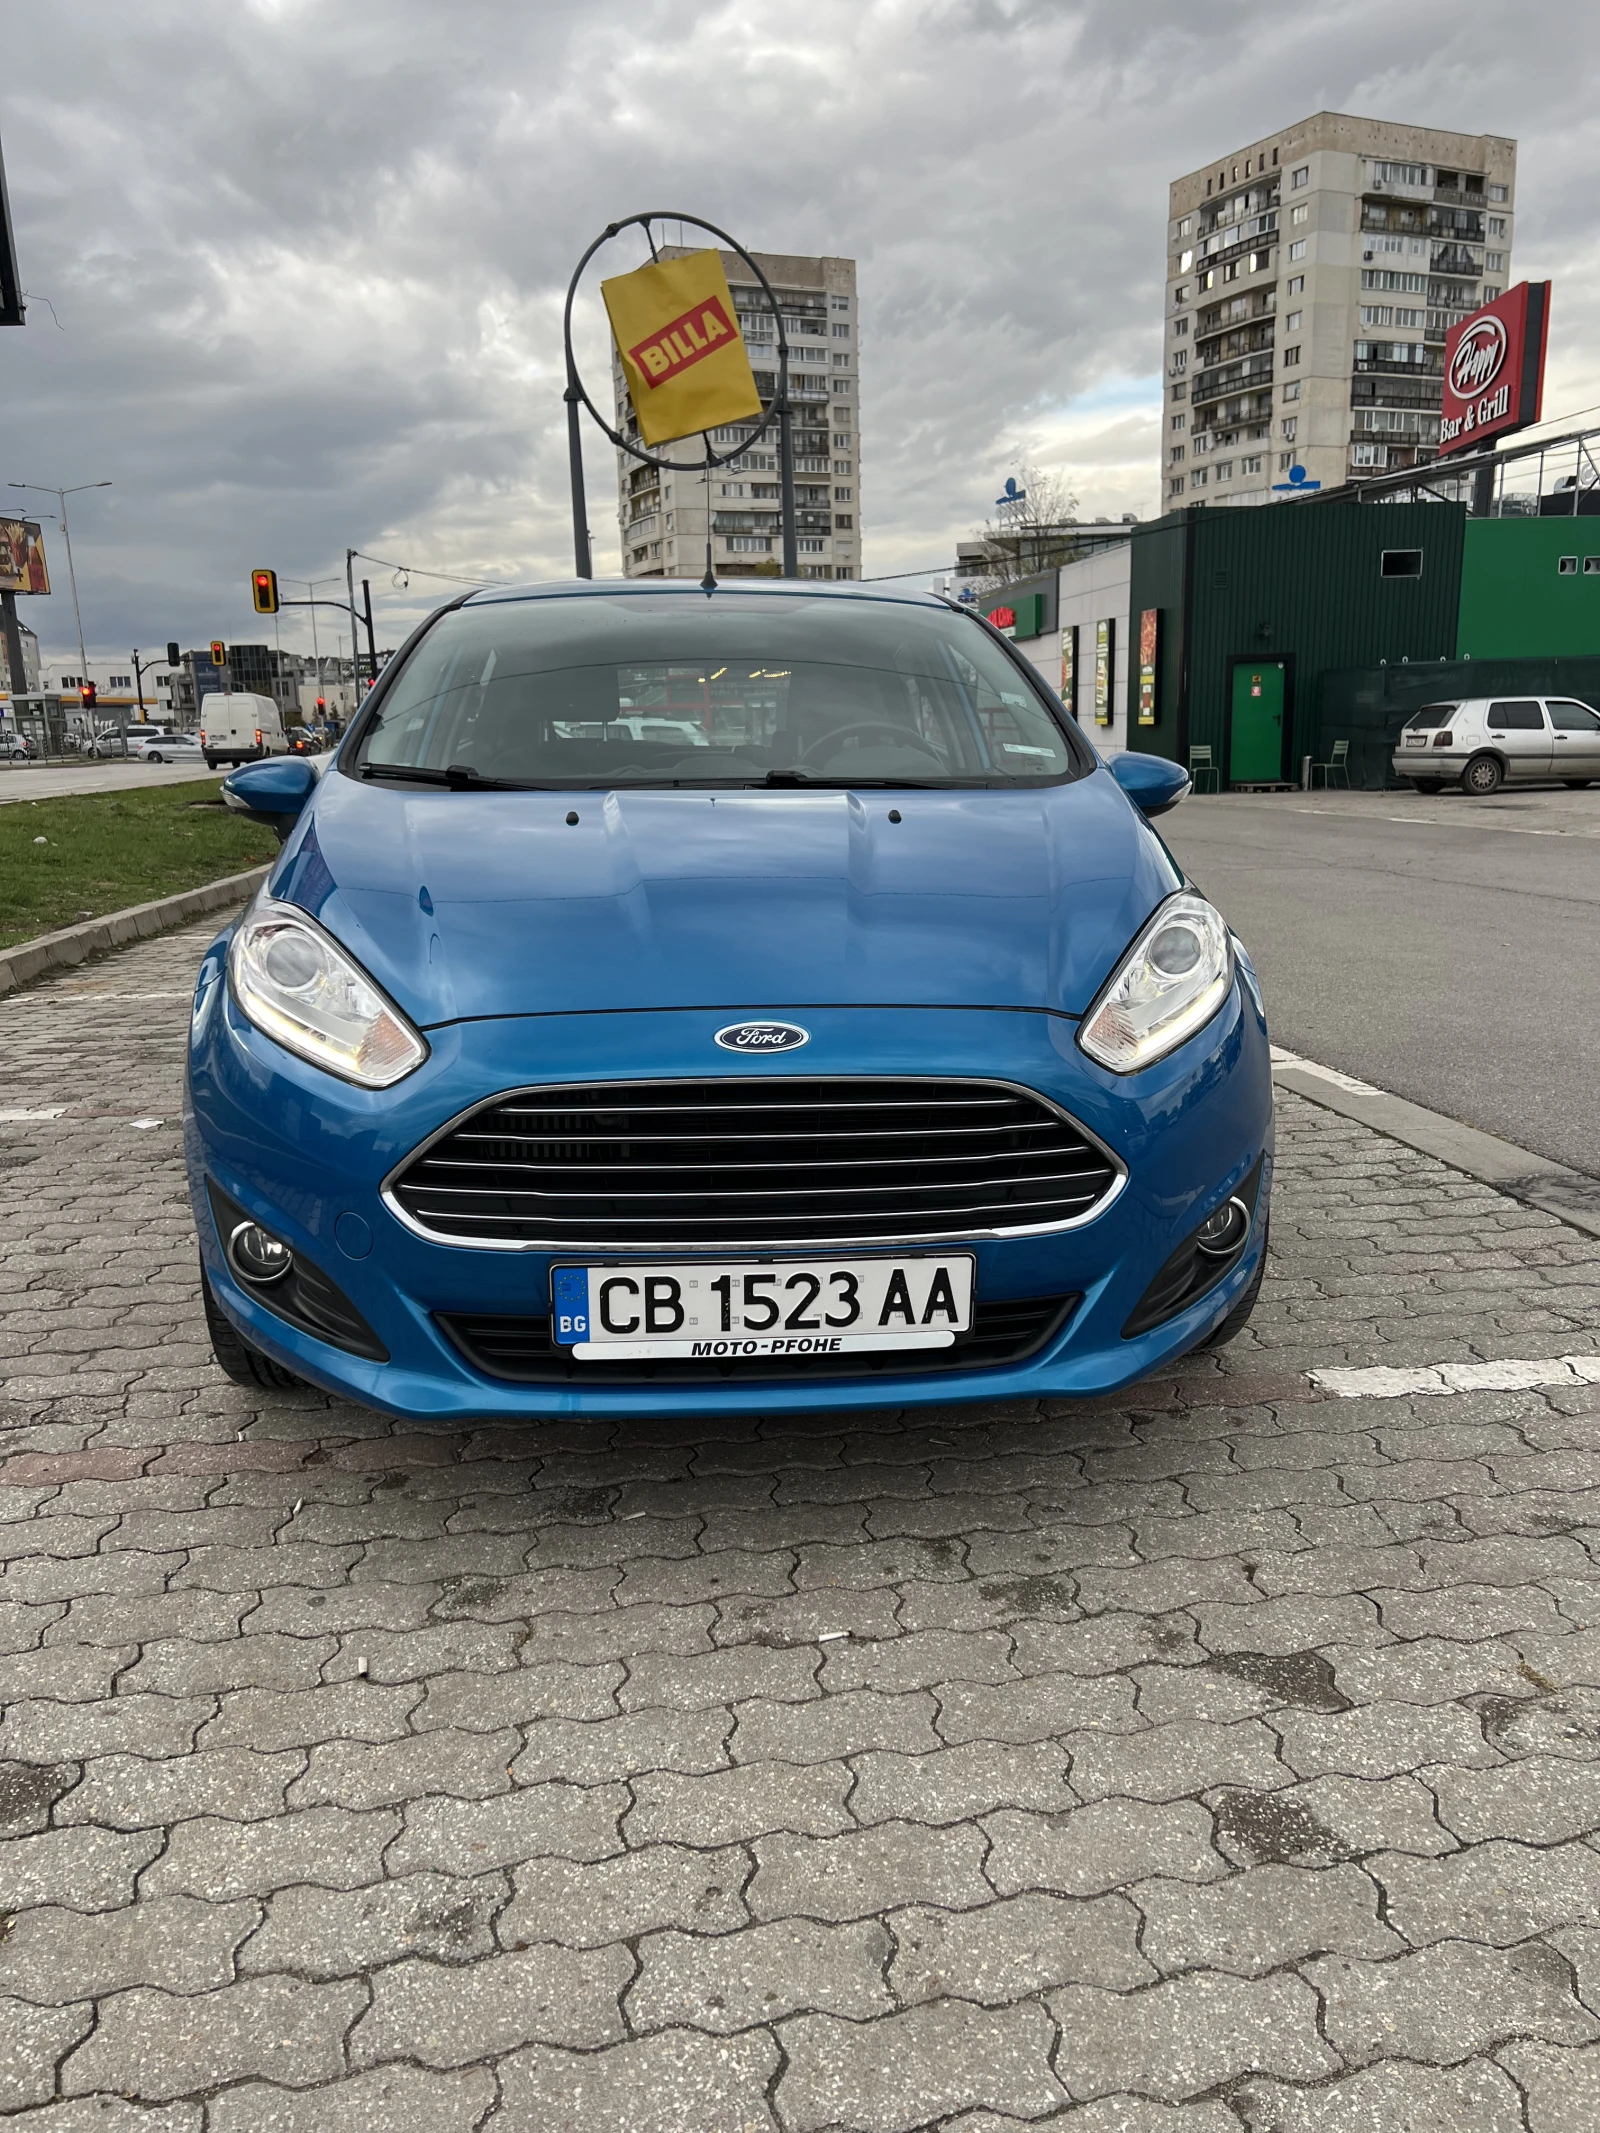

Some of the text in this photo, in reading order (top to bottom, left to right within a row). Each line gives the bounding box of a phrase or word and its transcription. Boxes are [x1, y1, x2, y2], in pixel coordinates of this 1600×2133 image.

[639, 310, 728, 377] BILLA
[1456, 339, 1500, 389] Happy
[1439, 384, 1510, 445] Bar & Grill
[736, 1027, 788, 1045] Ford
[560, 1267, 960, 1335] BG CB 1523 AA
[691, 1337, 843, 1357] MOTO-PFOHE
